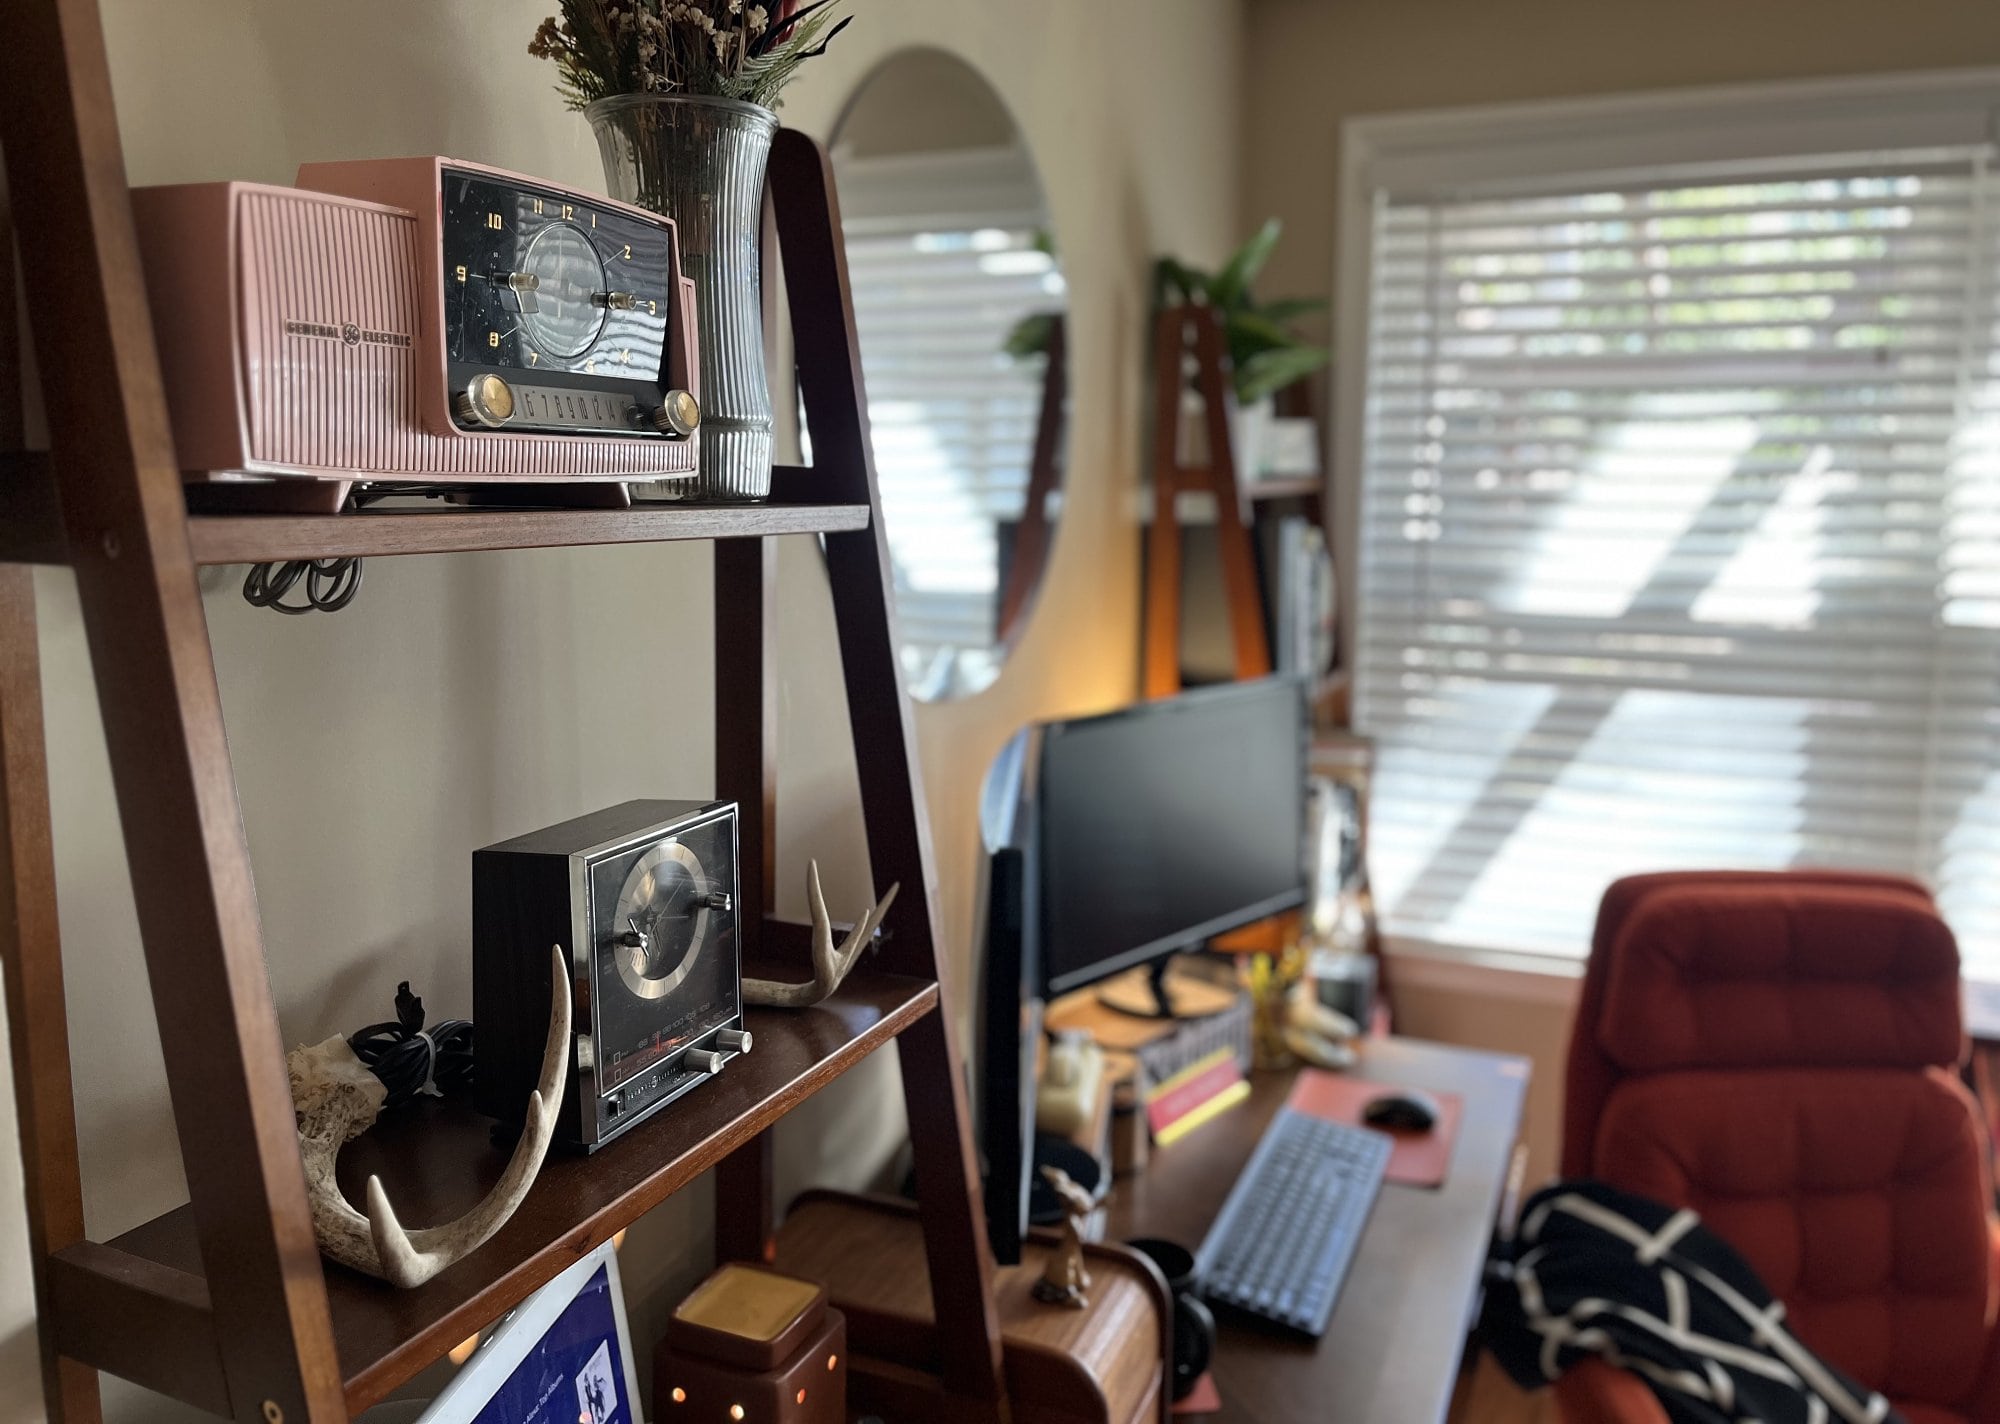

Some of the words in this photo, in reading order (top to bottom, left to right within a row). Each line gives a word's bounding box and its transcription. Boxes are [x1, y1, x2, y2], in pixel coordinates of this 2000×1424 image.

[533, 199, 543, 215] 11
[562, 204, 573, 221] 12
[488, 212, 502, 230] 10
[591, 213, 596, 229] 1
[624, 244, 631, 260] 2
[456, 265, 466, 282] 9
[648, 300, 656, 316] 3
[286, 321, 341, 339] GENERAL
[362, 329, 411, 348] ELECTRIC
[489, 331, 499, 348] 8
[530, 351, 538, 367] 7
[620, 348, 629, 364] 4
[525, 393, 535, 417] 6
[541, 394, 549, 418] 7
[554, 394, 564, 419] 8
[566, 396, 576, 419] 9
